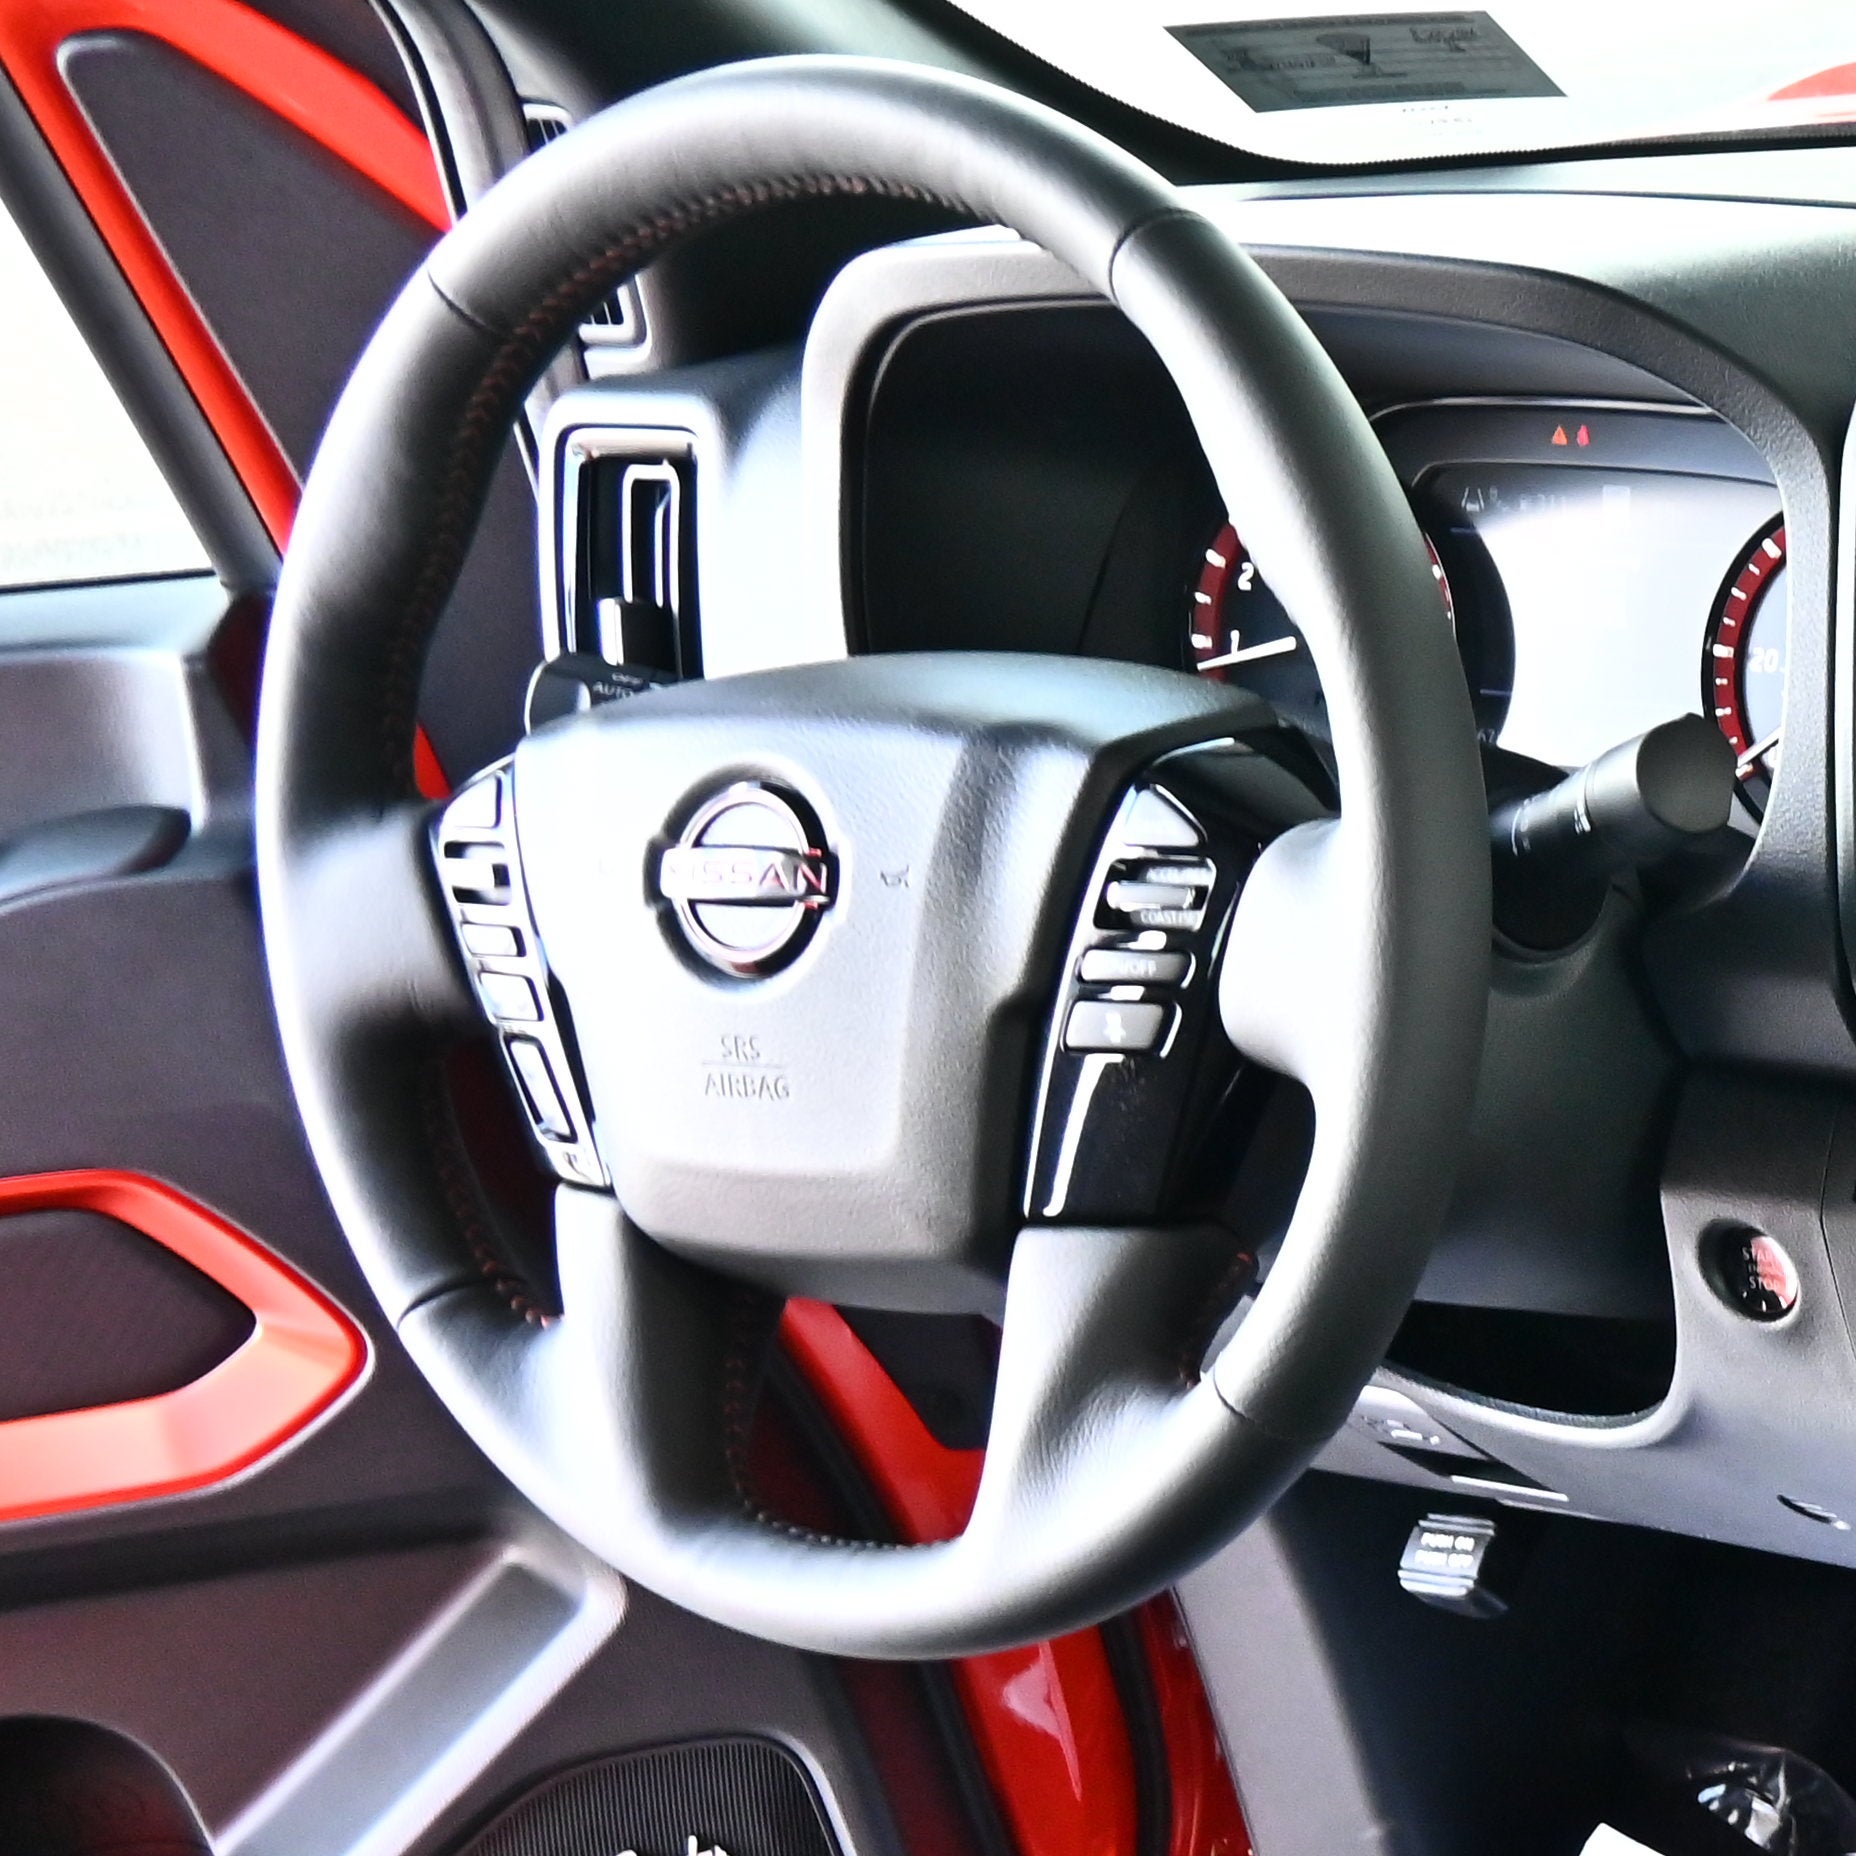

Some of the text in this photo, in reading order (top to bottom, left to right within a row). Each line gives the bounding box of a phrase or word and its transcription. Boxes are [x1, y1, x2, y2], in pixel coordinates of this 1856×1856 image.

[1238, 562, 1254, 591] 2
[1750, 647, 1779, 673] 20
[720, 1034, 762, 1063] SRS
[703, 1071, 791, 1101] AIRBAG
